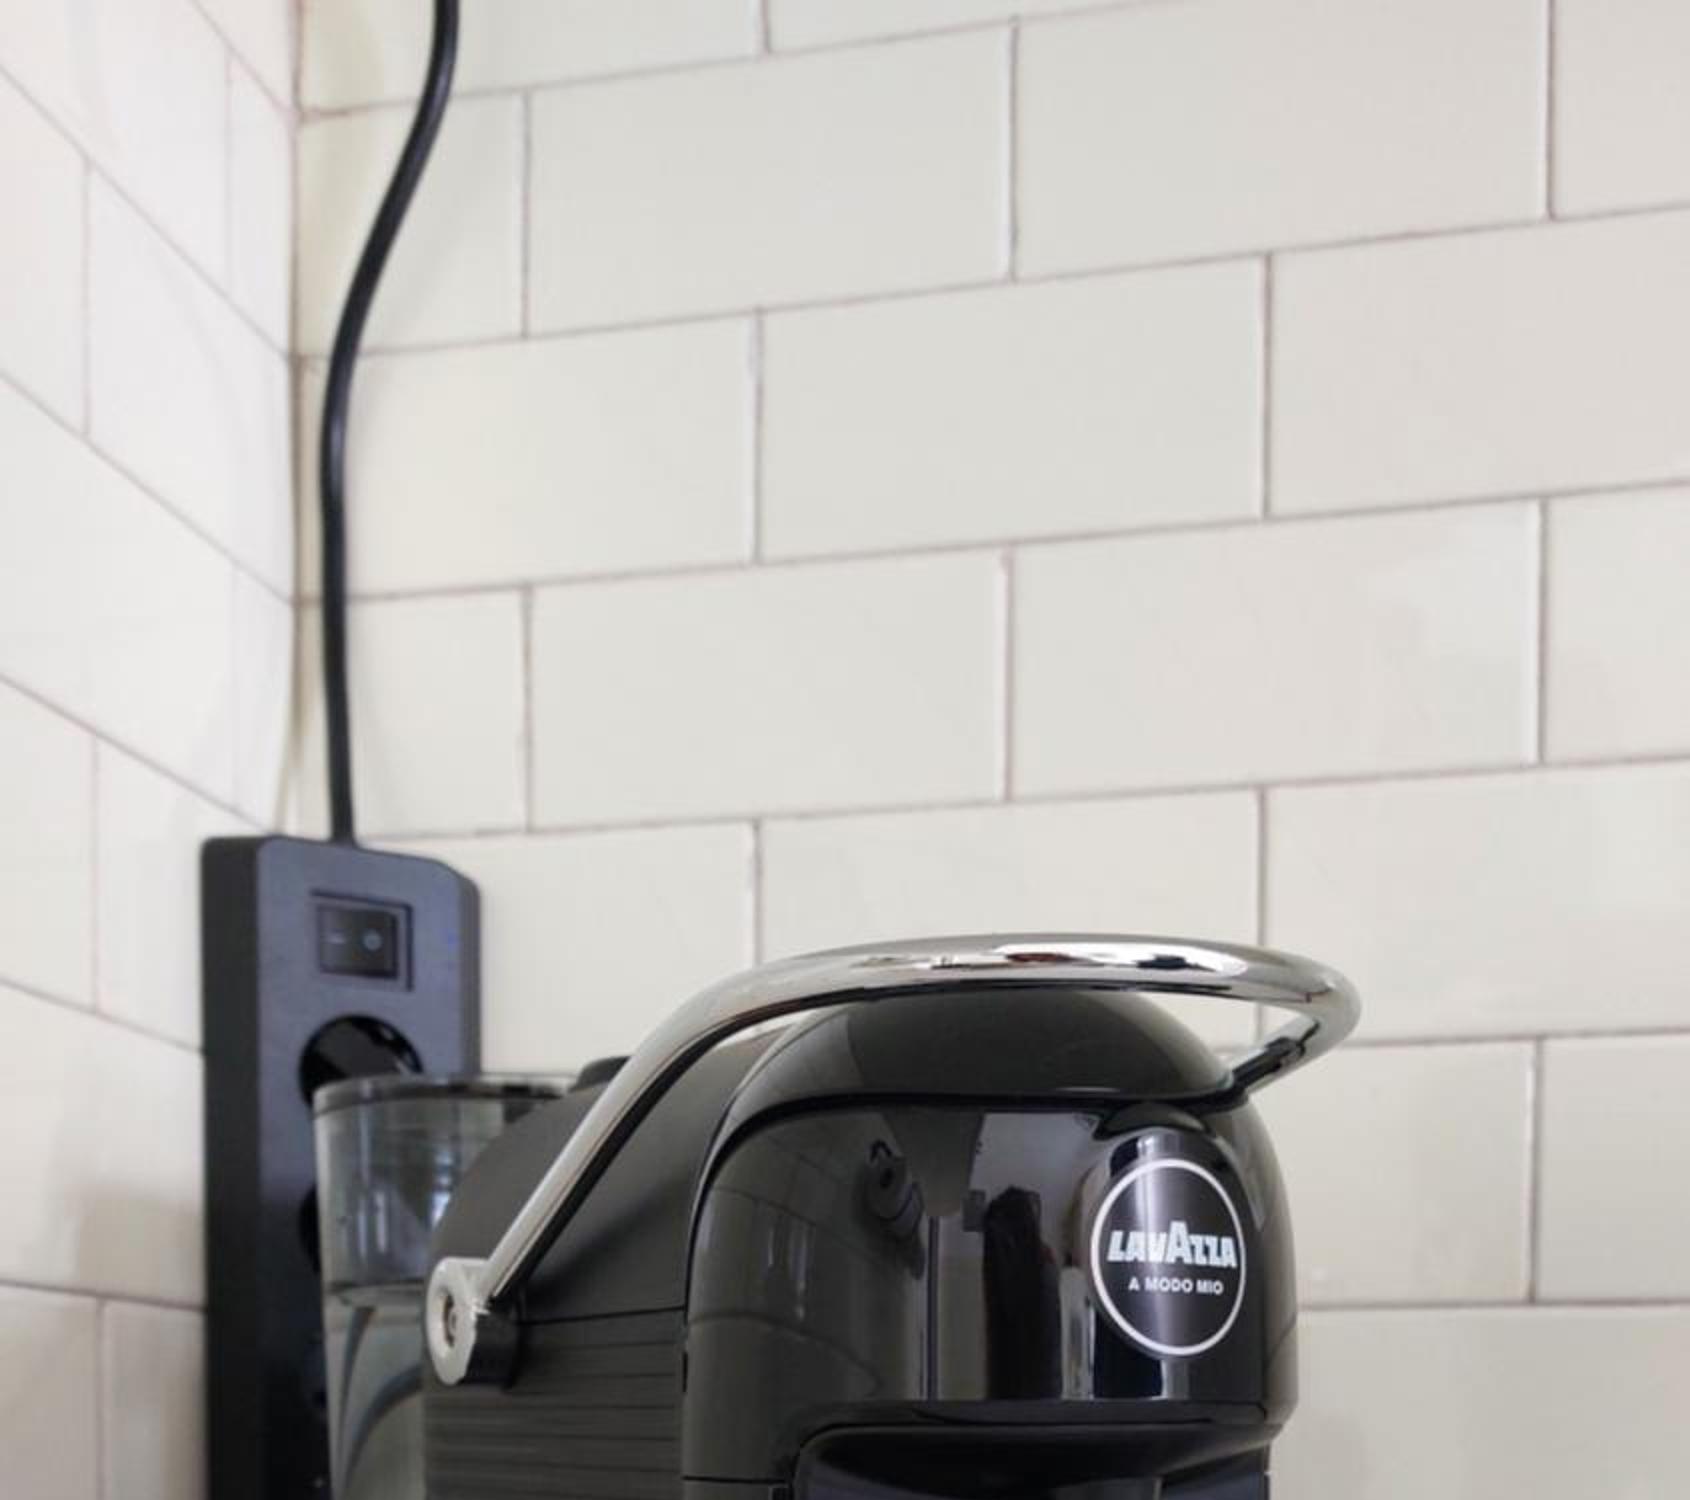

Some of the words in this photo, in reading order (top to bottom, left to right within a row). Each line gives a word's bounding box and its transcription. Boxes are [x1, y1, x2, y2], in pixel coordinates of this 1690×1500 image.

[1107, 1221, 1237, 1268] LAVAZZA
[1128, 1277, 1140, 1291] A
[1145, 1277, 1193, 1293] MODO
[1196, 1279, 1223, 1294] MIO
